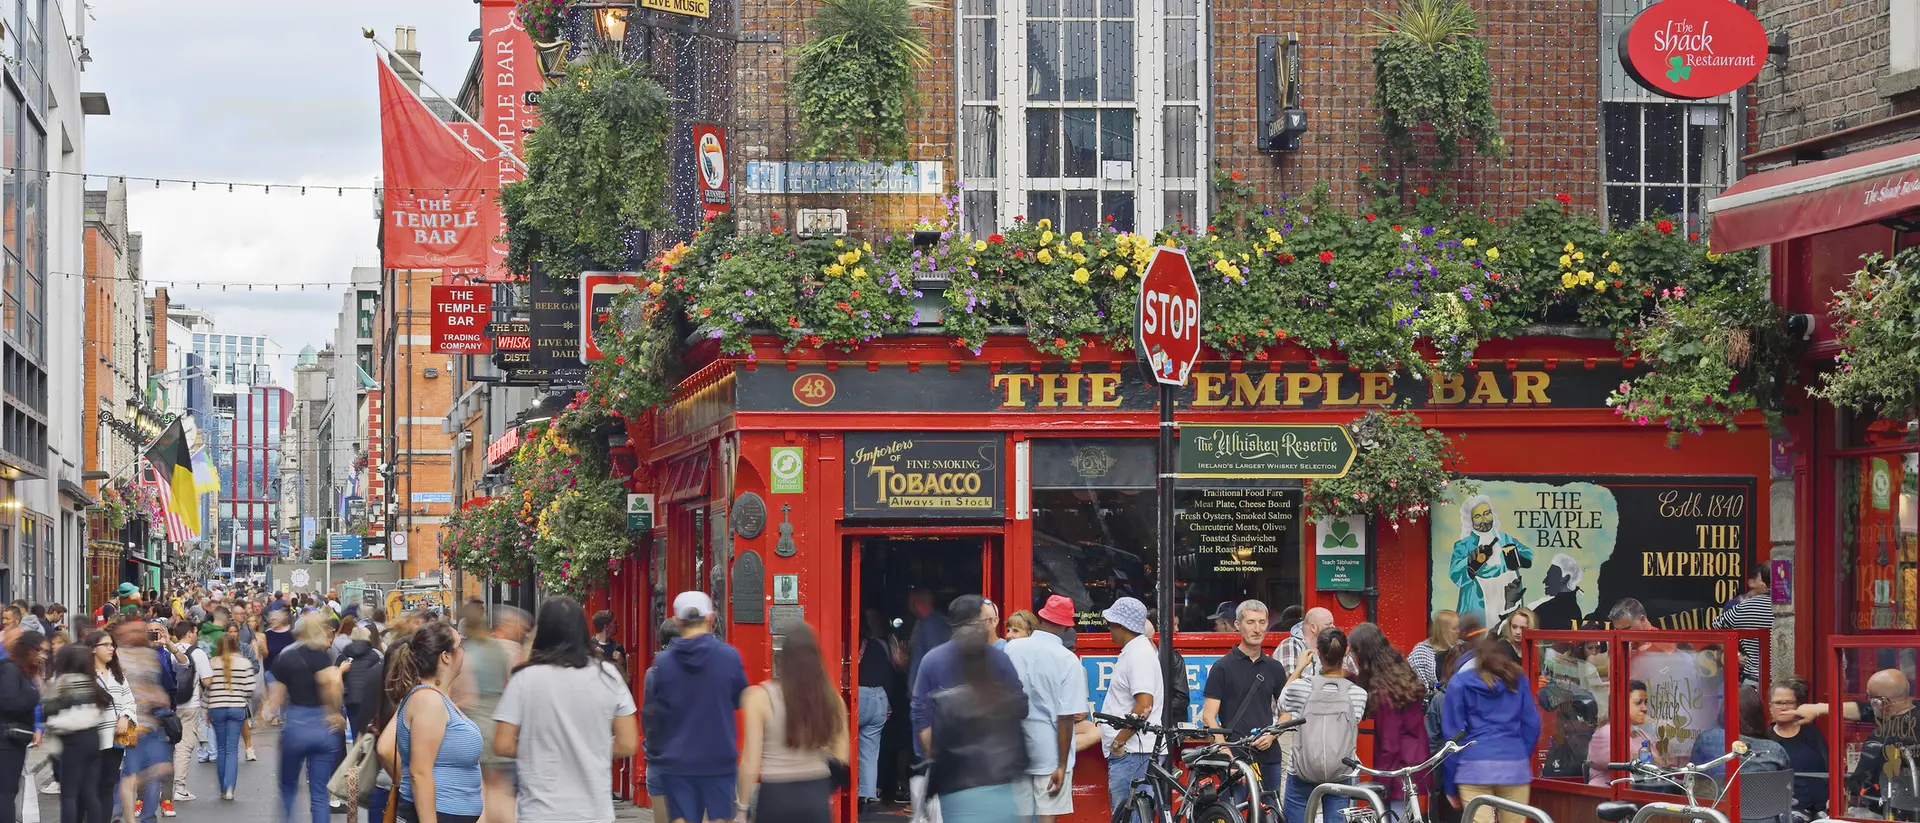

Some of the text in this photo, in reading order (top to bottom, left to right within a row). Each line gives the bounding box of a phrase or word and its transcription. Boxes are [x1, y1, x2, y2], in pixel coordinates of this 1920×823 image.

[673, 0, 704, 14] MUSIC
[1674, 18, 1693, 34] The
[1654, 20, 1714, 56] Shack
[497, 39, 515, 87] BAR
[1685, 53, 1756, 67] Restaurant
[881, 165, 908, 176] THEA
[872, 178, 912, 190] SOUTH
[417, 198, 452, 211] THE
[392, 210, 479, 228] TEMPLE
[414, 229, 459, 245] BAR
[450, 290, 474, 301] THE
[437, 303, 486, 314] TEMPLE
[534, 302, 560, 310] BEER
[448, 316, 474, 326] BAR
[1144, 289, 1197, 341] STOP
[490, 324, 510, 332] THE
[440, 342, 482, 350] COMPANY
[537, 338, 562, 347] LIVE
[799, 378, 827, 399] 48
[992, 370, 1552, 408] THE EMPLE BAR
[1193, 429, 1338, 460] The Whiskey Reserve
[850, 438, 914, 466] Importers
[890, 454, 901, 462] OF
[906, 460, 980, 469] FINE SMOKING
[867, 465, 981, 504] TOBACCO
[1202, 489, 1283, 497] Traditional Food Fare
[891, 496, 991, 507] Always in Stock
[1194, 500, 1291, 509] Meat Plate, Cheese Board
[1536, 491, 1582, 510] THE
[1658, 490, 1744, 518] Estb. 1840
[1180, 512, 1201, 520] Fresh
[1203, 512, 1234, 521] Oysters,
[1235, 512, 1266, 520] Smoked
[1514, 511, 1602, 529] TEMPLE
[1189, 523, 1287, 532] Charcuterie Meats, Olives
[1201, 534, 1276, 542] Toasted Sandwiches
[1536, 530, 1582, 549] BAR
[1696, 525, 1740, 549] THE
[1199, 545, 1213, 553] Hot
[1215, 545, 1236, 553] Roast
[1258, 545, 1278, 553] Rolls
[1642, 551, 1742, 577] EMPEROR
[1714, 579, 1740, 604] OF
[1875, 698, 1917, 741] Shack
